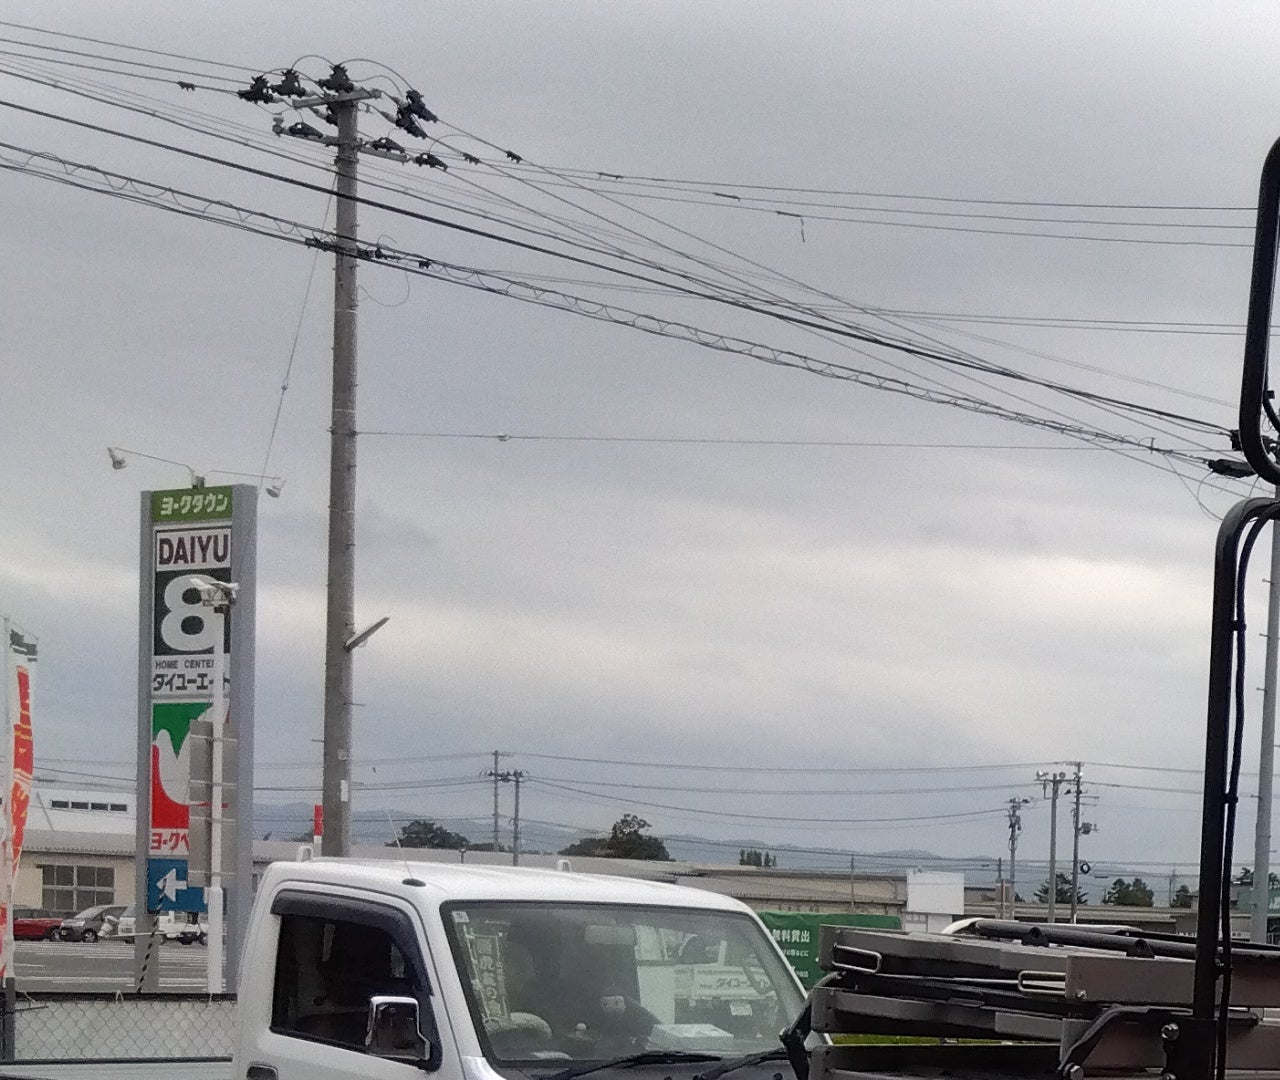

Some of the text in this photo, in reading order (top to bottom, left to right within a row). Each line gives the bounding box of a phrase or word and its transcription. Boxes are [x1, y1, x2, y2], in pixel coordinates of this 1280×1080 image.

[159, 534, 229, 565] DAIYU
[161, 574, 224, 652] 8
[155, 660, 179, 670] HOME
